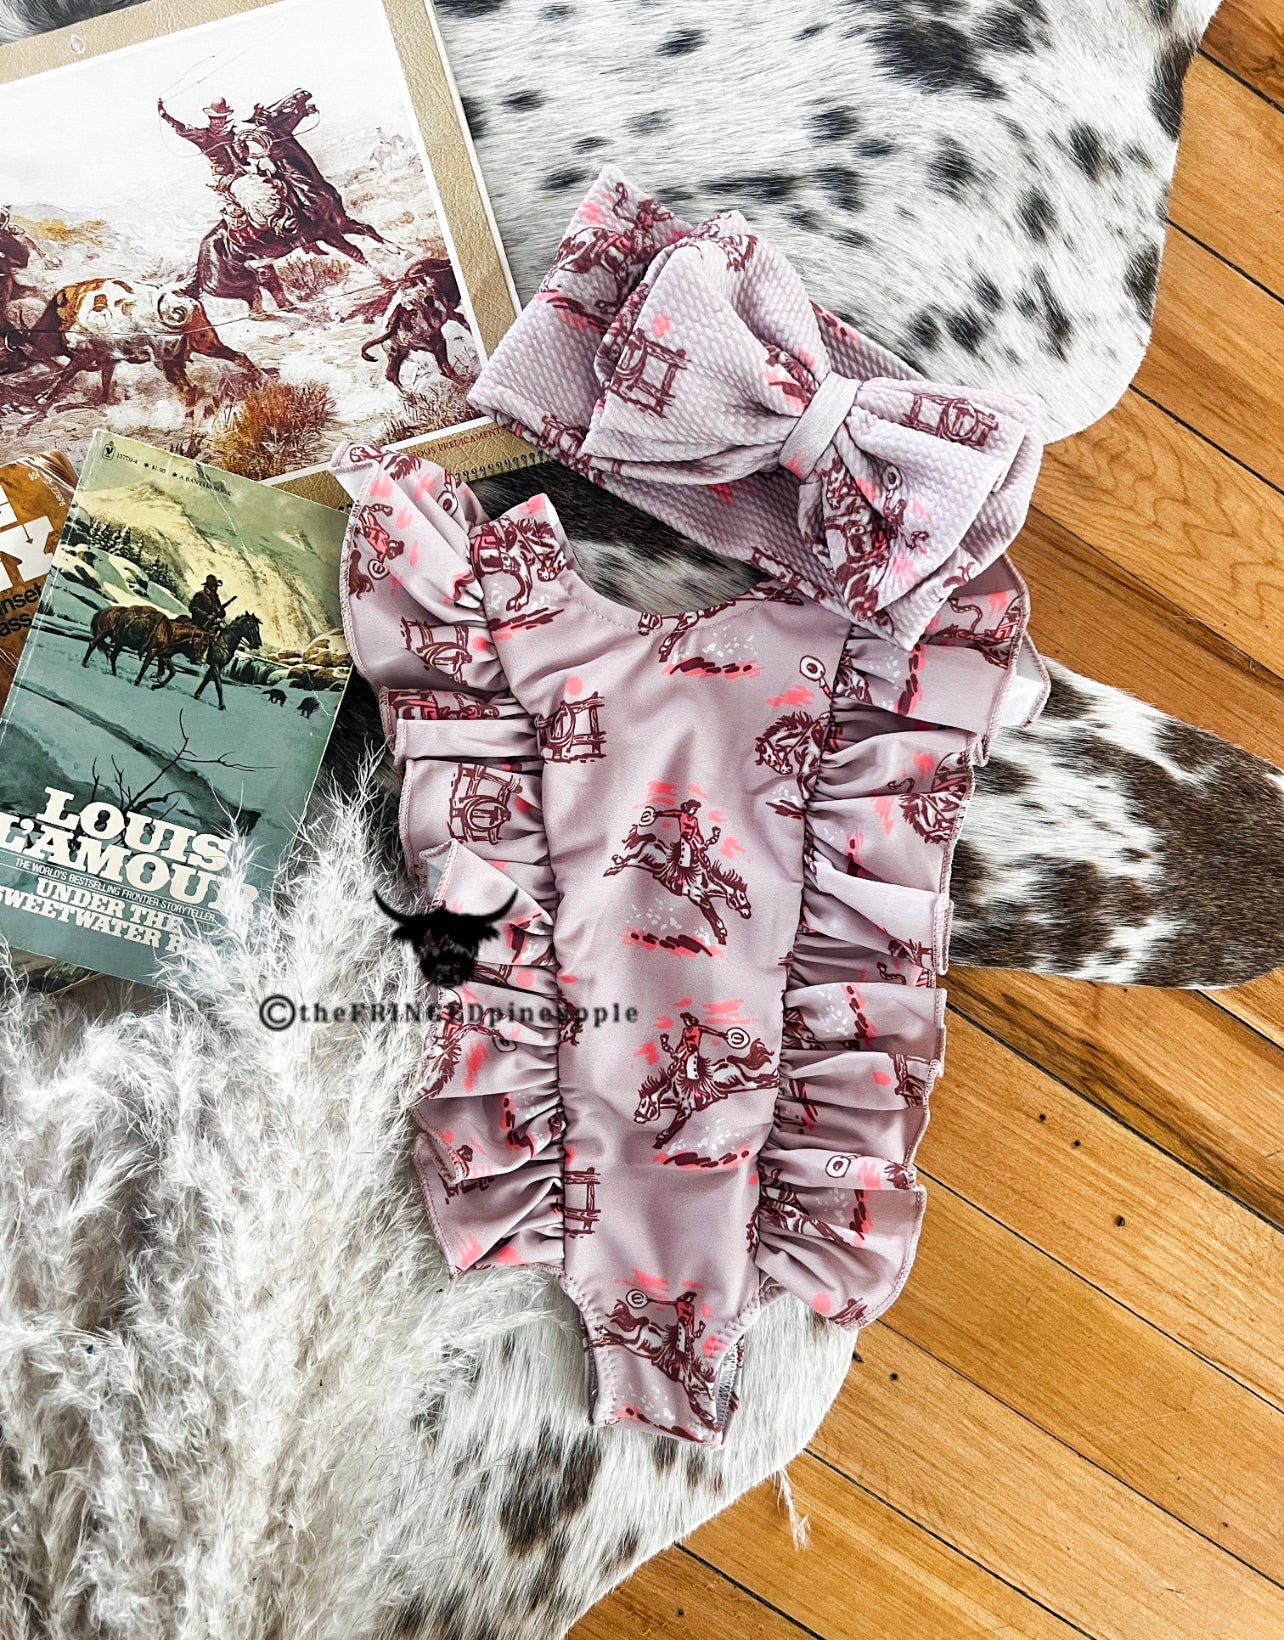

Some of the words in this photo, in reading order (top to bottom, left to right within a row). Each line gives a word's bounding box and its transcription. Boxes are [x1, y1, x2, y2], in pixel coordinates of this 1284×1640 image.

[438, 427, 501, 451] PREDICAMENT
[36, 787, 232, 872] LOUIS
[15, 858, 31, 870] THE
[32, 862, 67, 880] WORLD'S
[68, 873, 121, 896] BESTSELLING
[121, 889, 160, 907] FRONTIER
[160, 901, 216, 922] STORYTELLER
[36, 876, 125, 919] UNDER
[129, 903, 184, 934] THE
